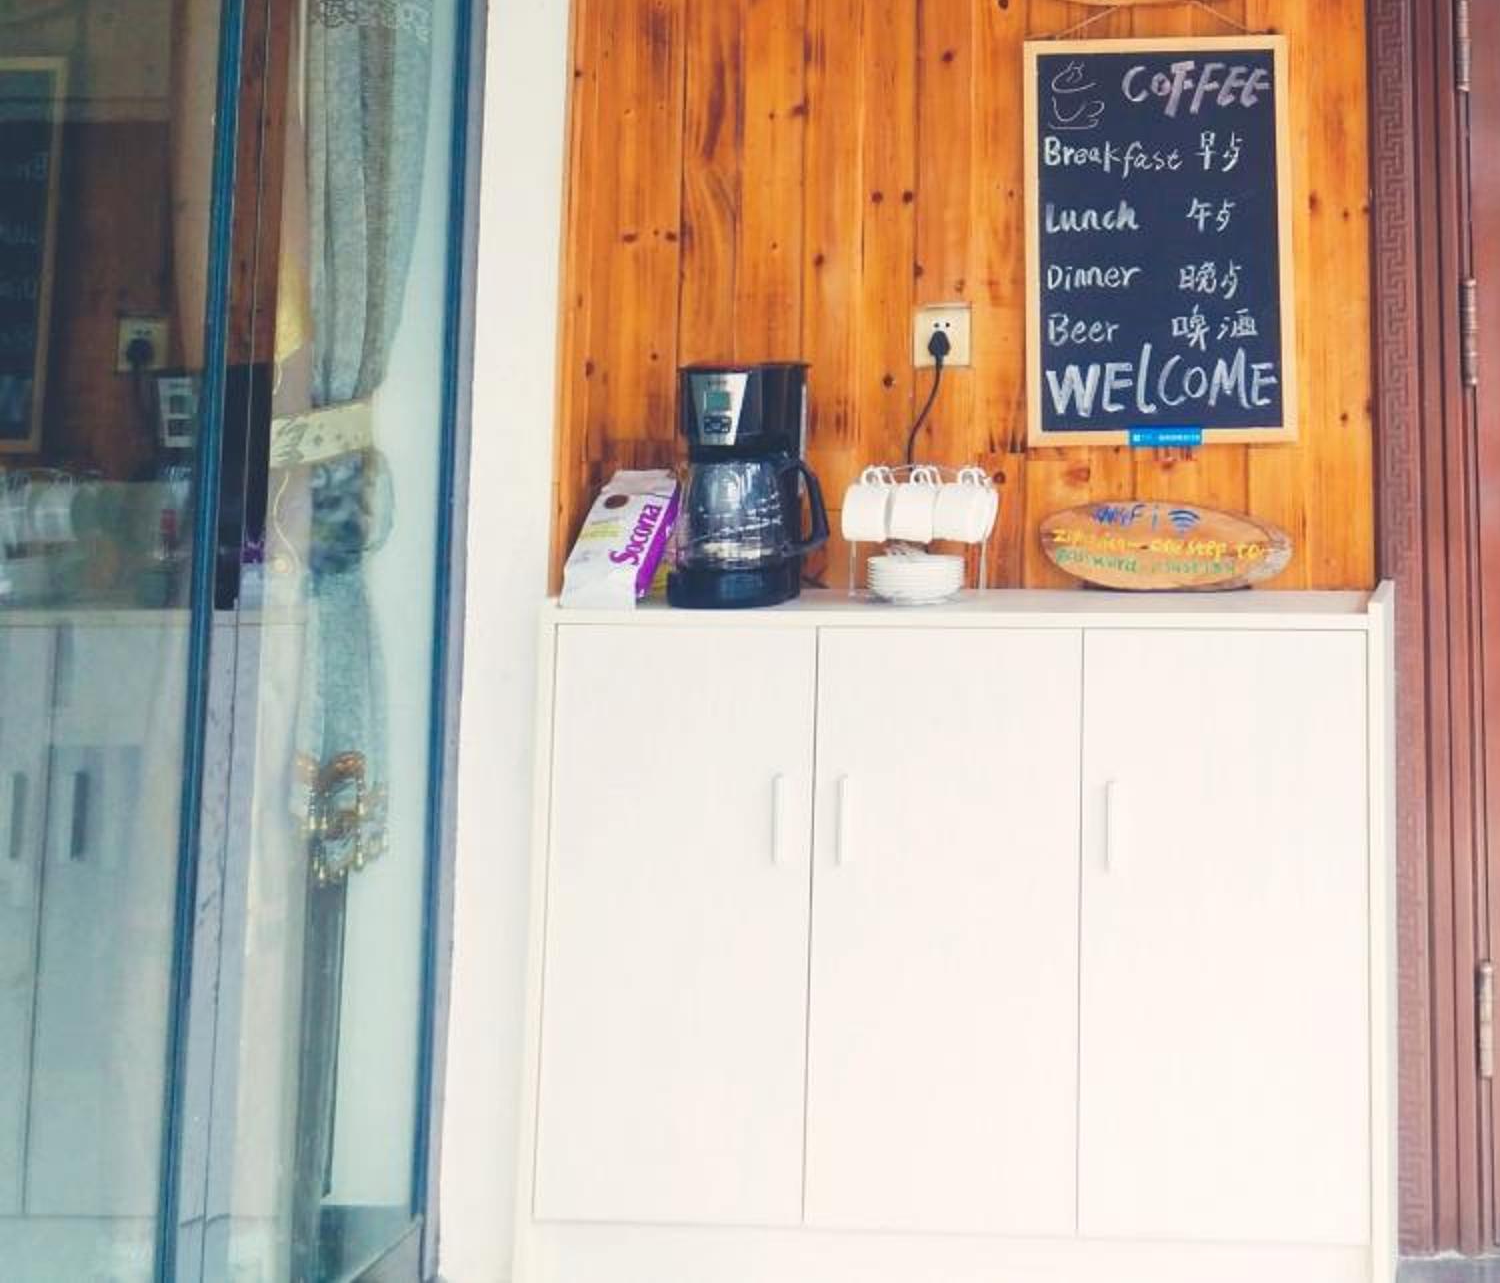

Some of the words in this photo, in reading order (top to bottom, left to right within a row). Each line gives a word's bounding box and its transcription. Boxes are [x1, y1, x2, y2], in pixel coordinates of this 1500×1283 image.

[1044, 136, 1183, 179] Breakfast
[1045, 200, 1140, 234] Lunch
[1046, 263, 1141, 291] Dinner
[1047, 312, 1120, 346] Beer
[1171, 304, 1258, 352] 啤酒
